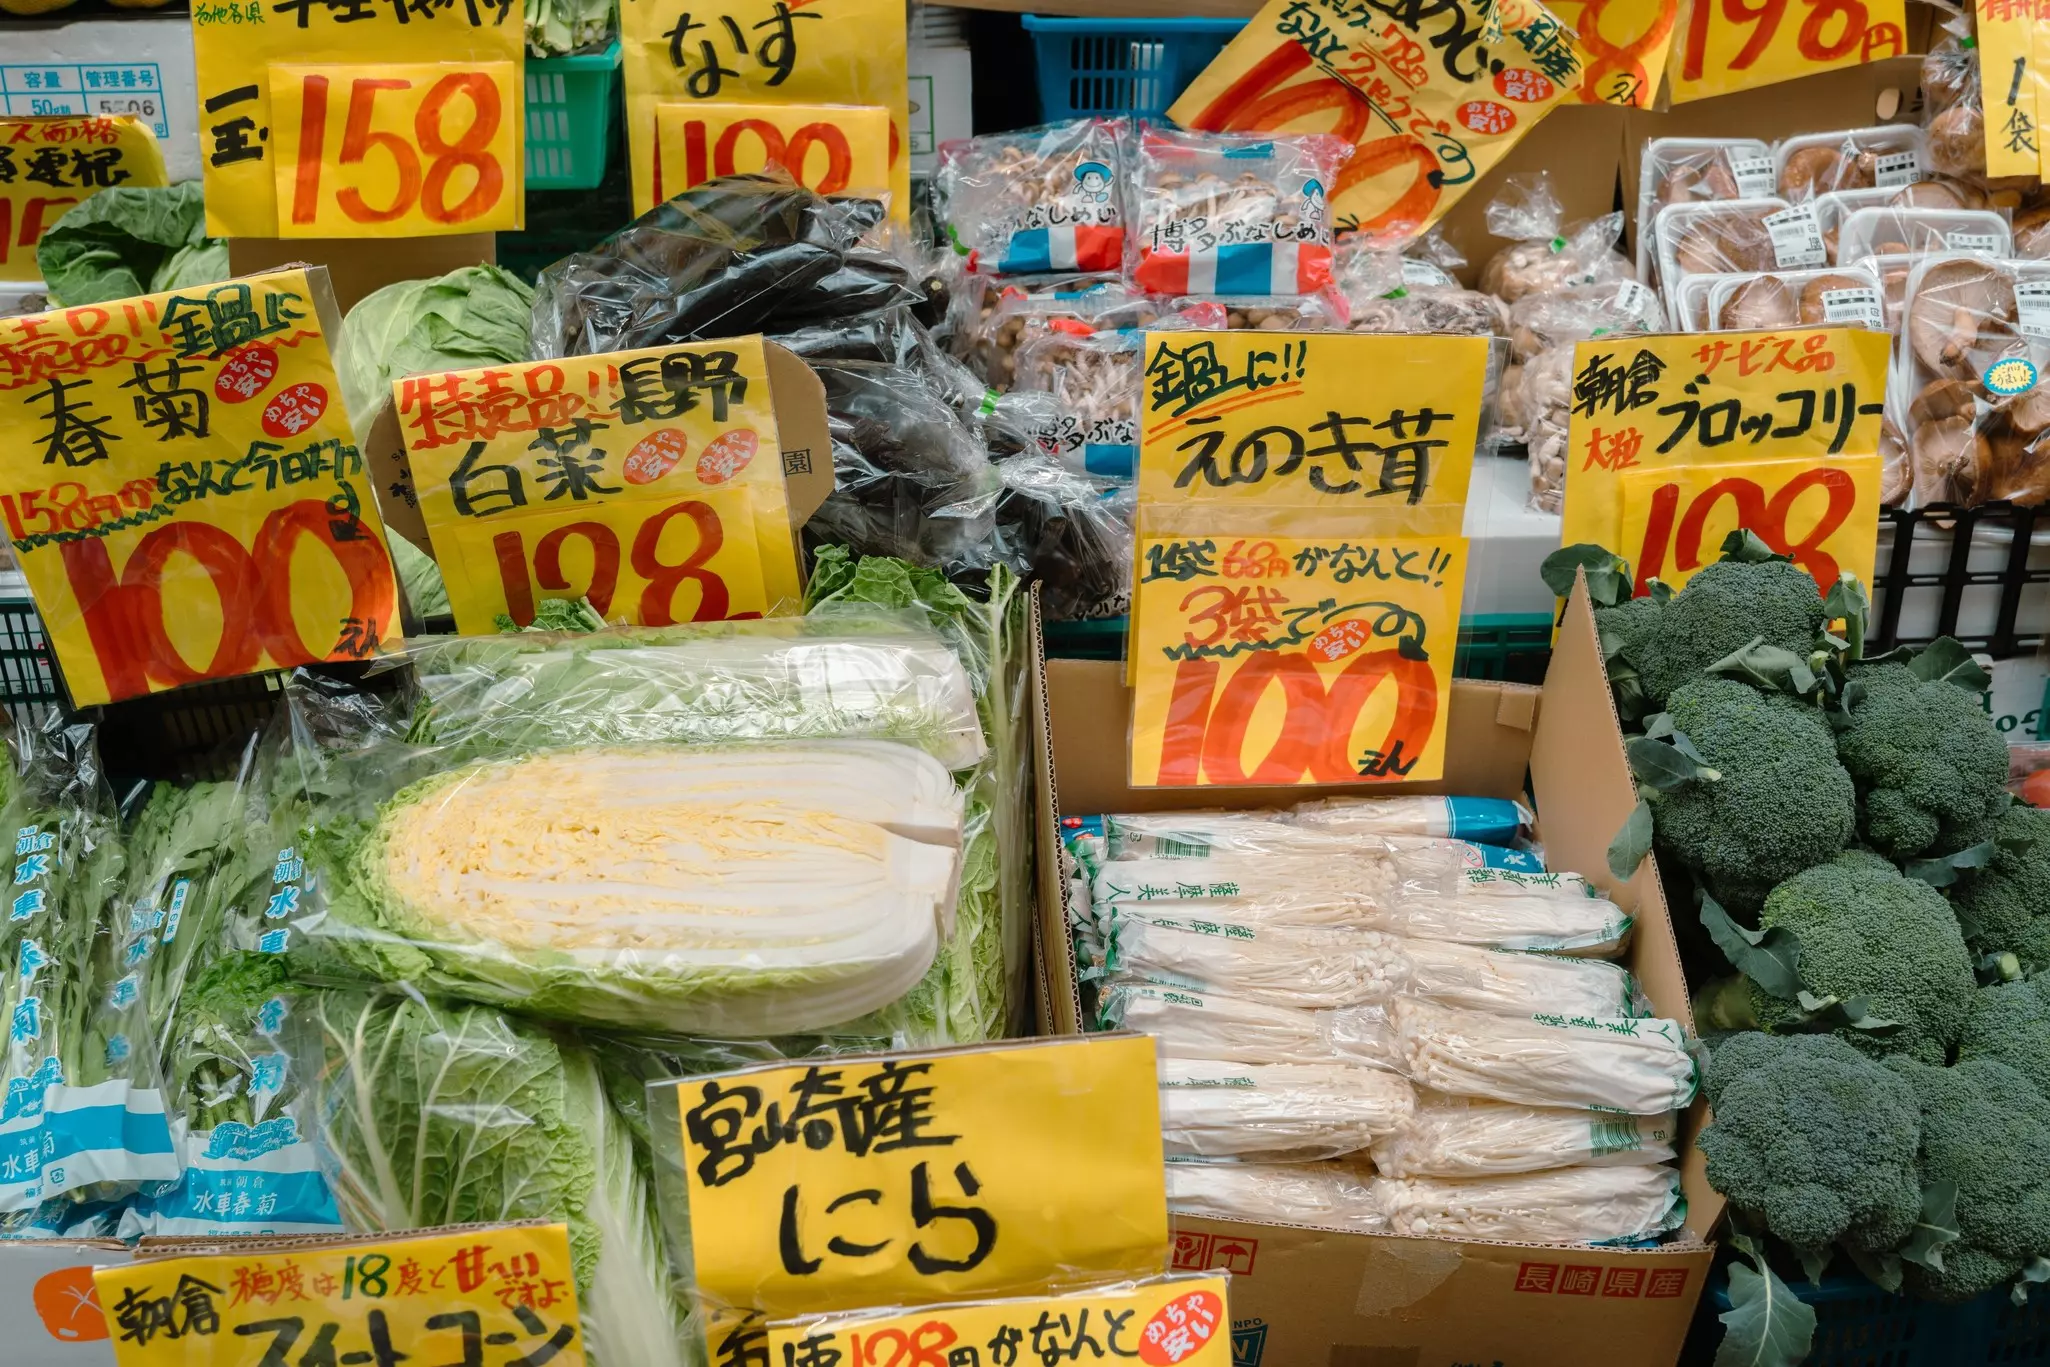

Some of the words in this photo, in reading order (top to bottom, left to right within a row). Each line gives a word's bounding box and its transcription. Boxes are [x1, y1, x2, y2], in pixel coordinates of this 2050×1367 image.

[24, 71, 62, 88] 容量
[86, 70, 154, 87] 管理番号
[662, 2, 823, 98] なす
[292, 72, 504, 225] 158
[159, 284, 307, 360] 鍋に
[1691, 335, 1836, 377] サービス品
[24, 360, 211, 467] 春菊
[610, 351, 748, 424] 長野
[1145, 340, 1308, 417] 鍋に!!
[1570, 349, 1668, 419] 朝倉
[1656, 373, 1885, 455] ブロッコリー
[448, 418, 624, 518] 白菜
[1174, 407, 1455, 506] えのき茸
[1582, 427, 1645, 473] 大粒
[60, 499, 395, 703] 100
[1156, 648, 1438, 785] 100
[1358, 740, 1420, 777] えん
[686, 1061, 964, 1188] 宮崎産
[192, 1190, 278, 1217] 水車春菊
[779, 1160, 998, 1277] にら
[114, 1274, 226, 1347] 朝倉
[1516, 1264, 1688, 1297] 長崎県産
